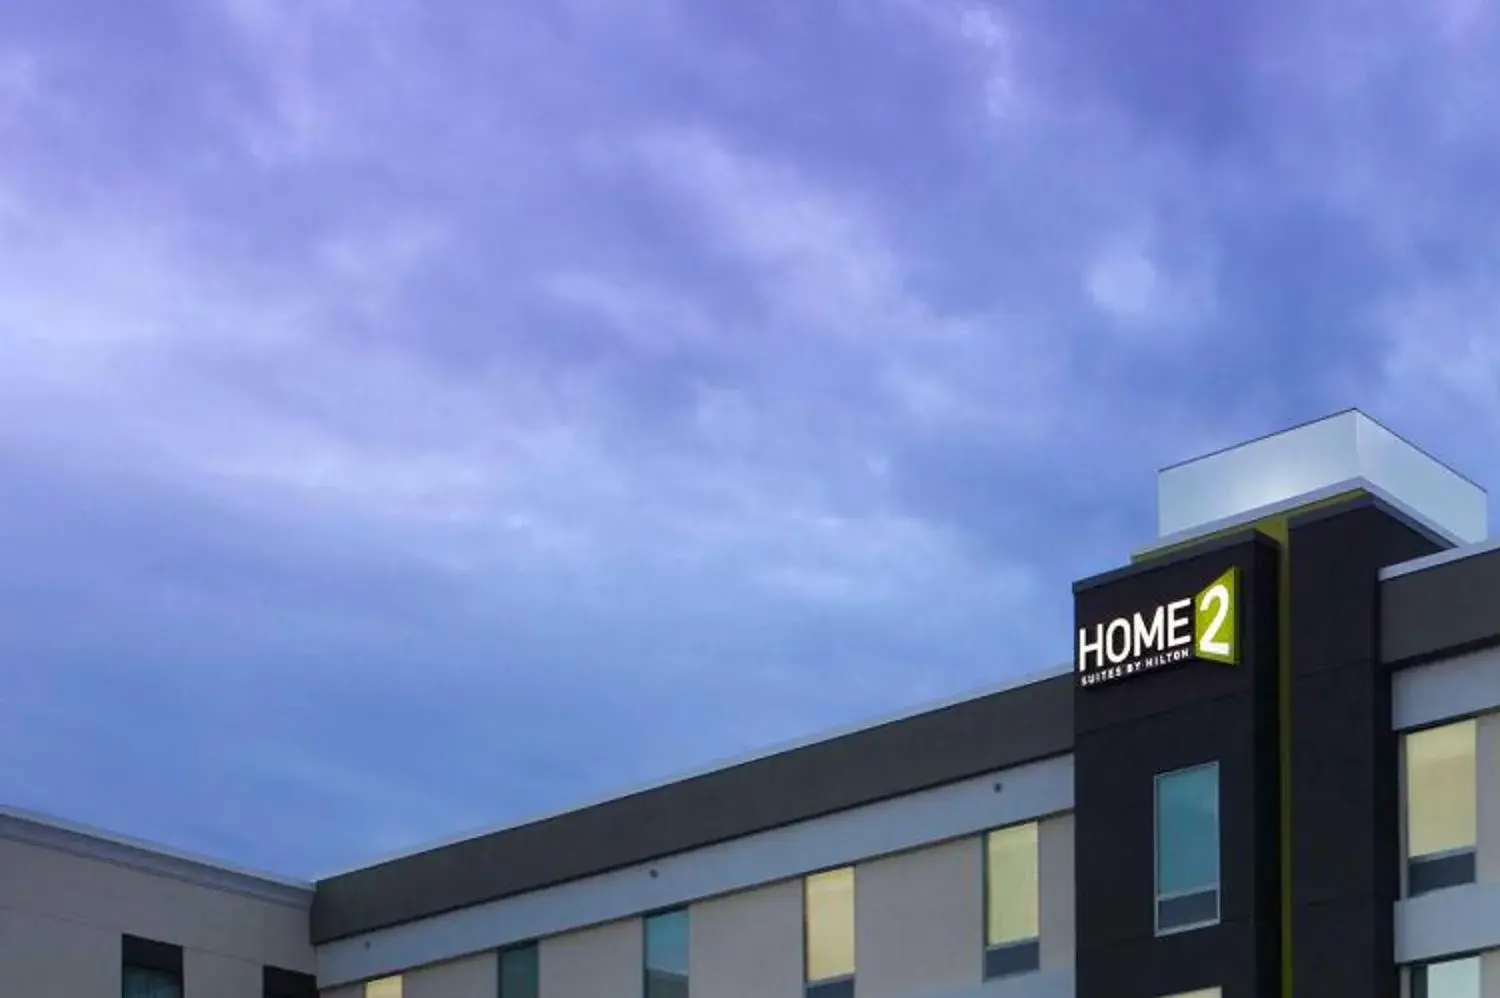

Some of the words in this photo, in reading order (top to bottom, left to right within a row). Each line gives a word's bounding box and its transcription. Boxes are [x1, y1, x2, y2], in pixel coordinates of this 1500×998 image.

[1081, 666, 1122, 687] SUITES
[1126, 661, 1141, 674] BY
[1145, 648, 1190, 667] HILTON
